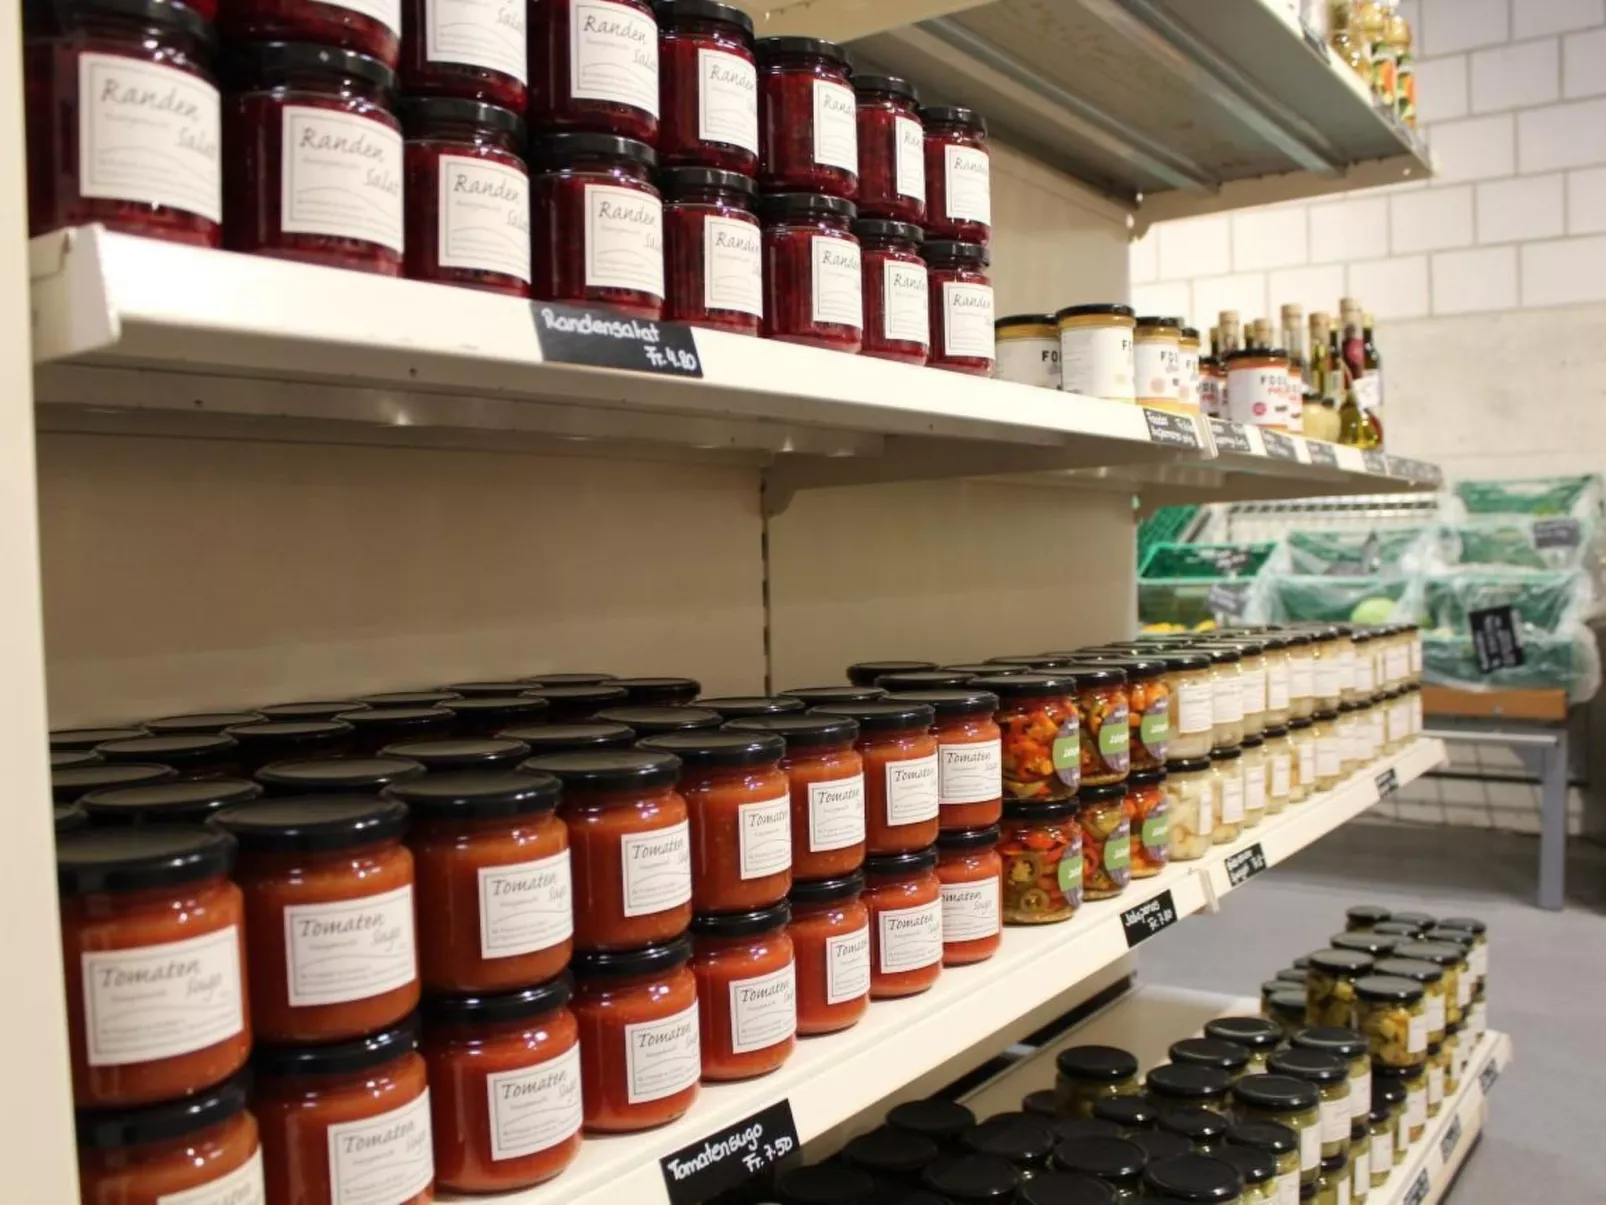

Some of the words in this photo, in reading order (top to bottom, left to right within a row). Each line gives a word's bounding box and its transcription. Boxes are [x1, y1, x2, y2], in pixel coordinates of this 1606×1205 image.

[583, 15, 648, 45] Randen
[101, 78, 203, 123] Randen
[298, 126, 385, 163] Randen
[453, 173, 521, 205] Randen
[540, 307, 661, 343] Randensalat
[490, 872, 557, 897] Tomaten
[297, 912, 385, 938] Tomaten
[97, 958, 202, 989] Tomaten
[500, 1070, 567, 1100] Tomaten
[343, 1119, 416, 1154] Tomaten
[667, 1123, 763, 1181] Tomatensugo
[742, 1152, 764, 1173] Fr.
